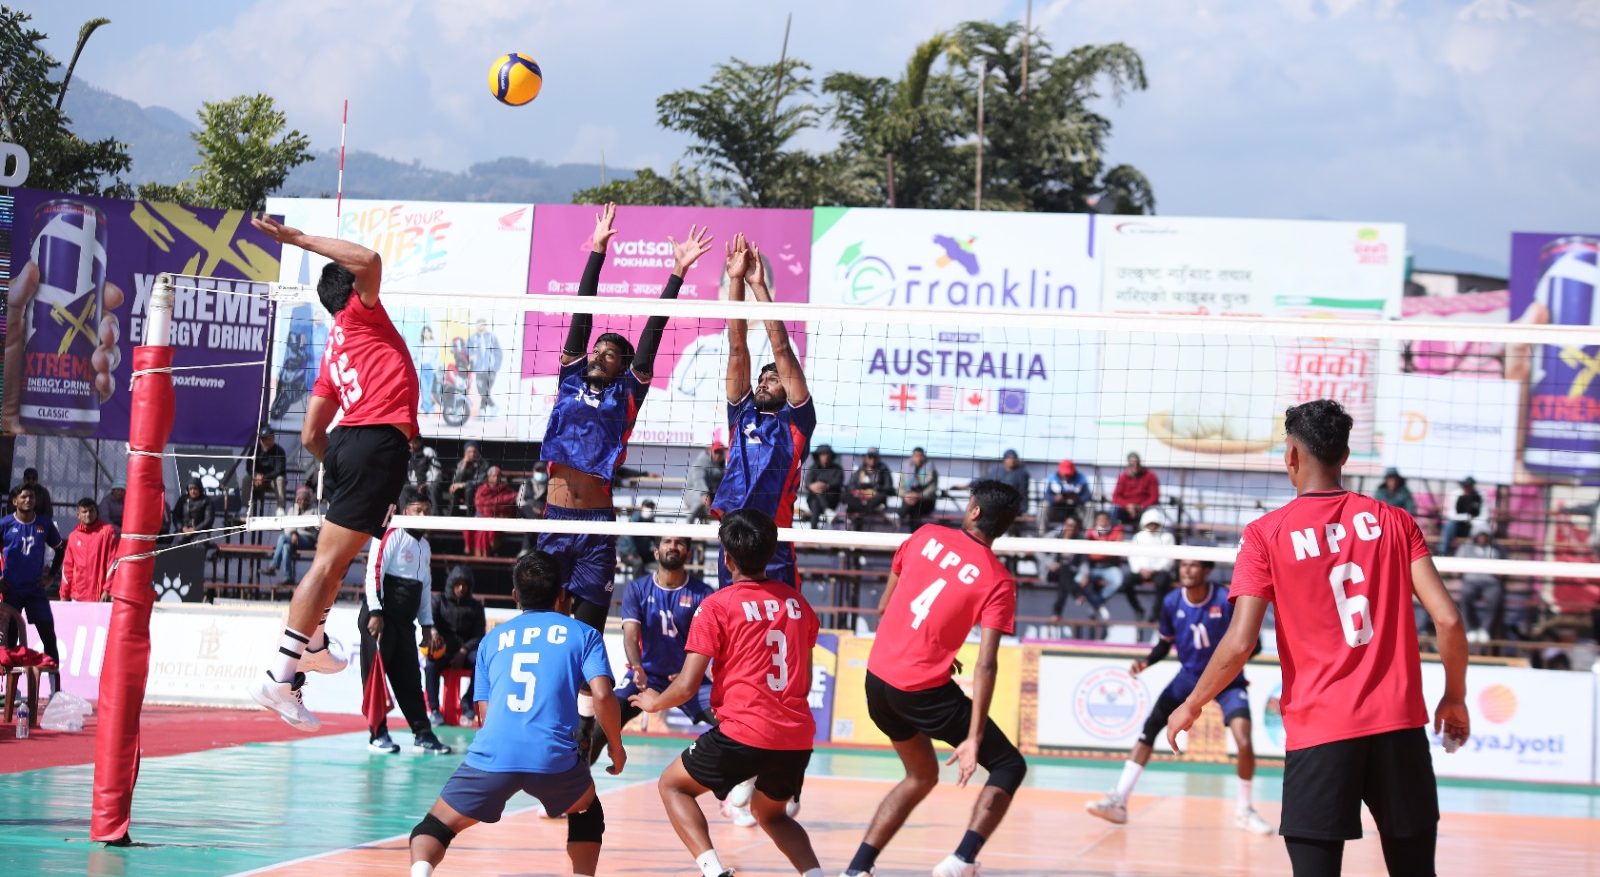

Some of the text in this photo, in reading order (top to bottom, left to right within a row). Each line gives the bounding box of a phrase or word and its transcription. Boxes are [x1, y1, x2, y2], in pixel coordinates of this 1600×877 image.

[341, 204, 444, 238] RIDE YOUR
[613, 257, 664, 268] POKHARA
[131, 273, 270, 326] XREME
[906, 266, 1077, 309] Franklin
[207, 322, 265, 352] DRINK
[868, 348, 1048, 381] AUSTRALIA
[63, 379, 91, 391] DRINK
[38, 408, 69, 419] CLASSIC
[21, 536, 35, 556] 17
[1290, 511, 1382, 562] NPC
[921, 537, 981, 585] NPC
[741, 597, 802, 622] NPC
[909, 577, 948, 631] 4
[1328, 561, 1374, 649] 6
[497, 624, 568, 652] NPC
[1190, 622, 1211, 650] 11
[765, 629, 788, 692] 3
[506, 652, 540, 713] 5
